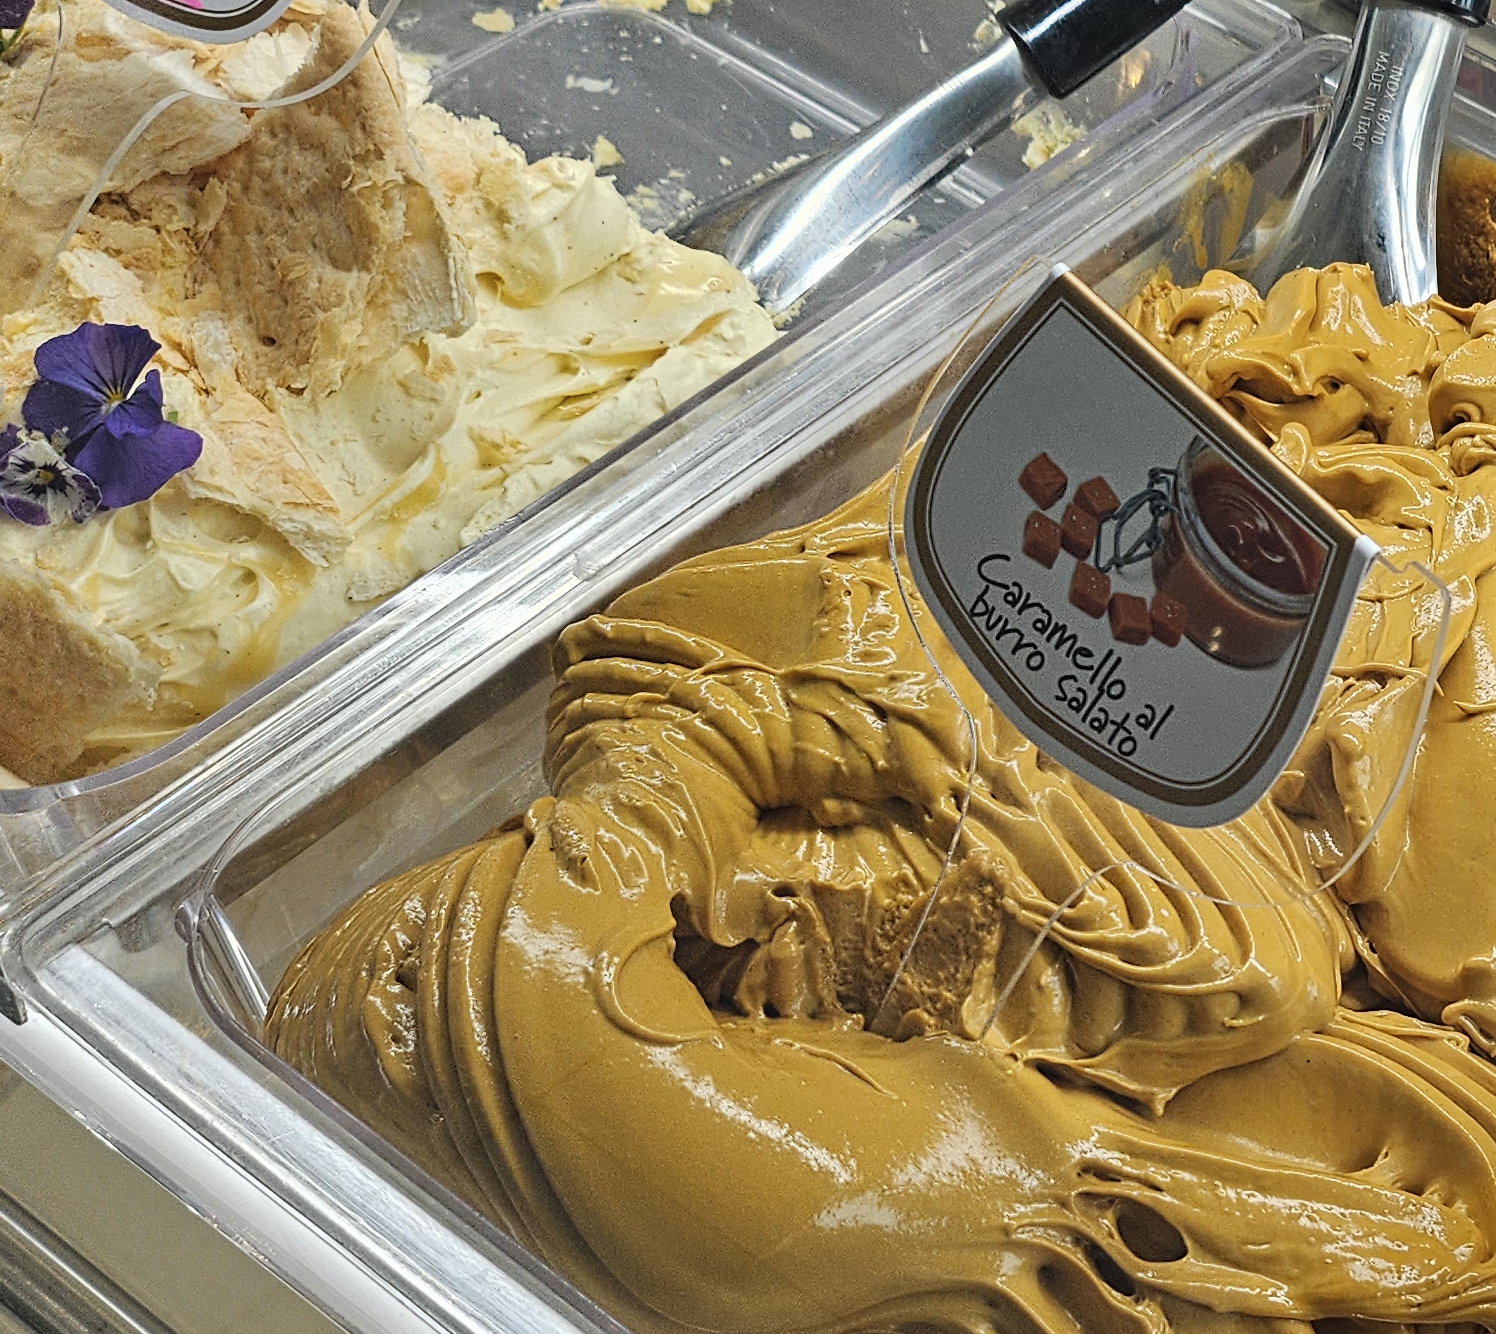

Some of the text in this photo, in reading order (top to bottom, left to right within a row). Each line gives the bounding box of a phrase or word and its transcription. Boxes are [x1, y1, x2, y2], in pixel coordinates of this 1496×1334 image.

[1352, 50, 1391, 152] MADE IN ITALY
[1370, 63, 1403, 146] INOX 18/10
[968, 584, 1138, 758] burro salato
[975, 553, 1175, 742] Caramello al
